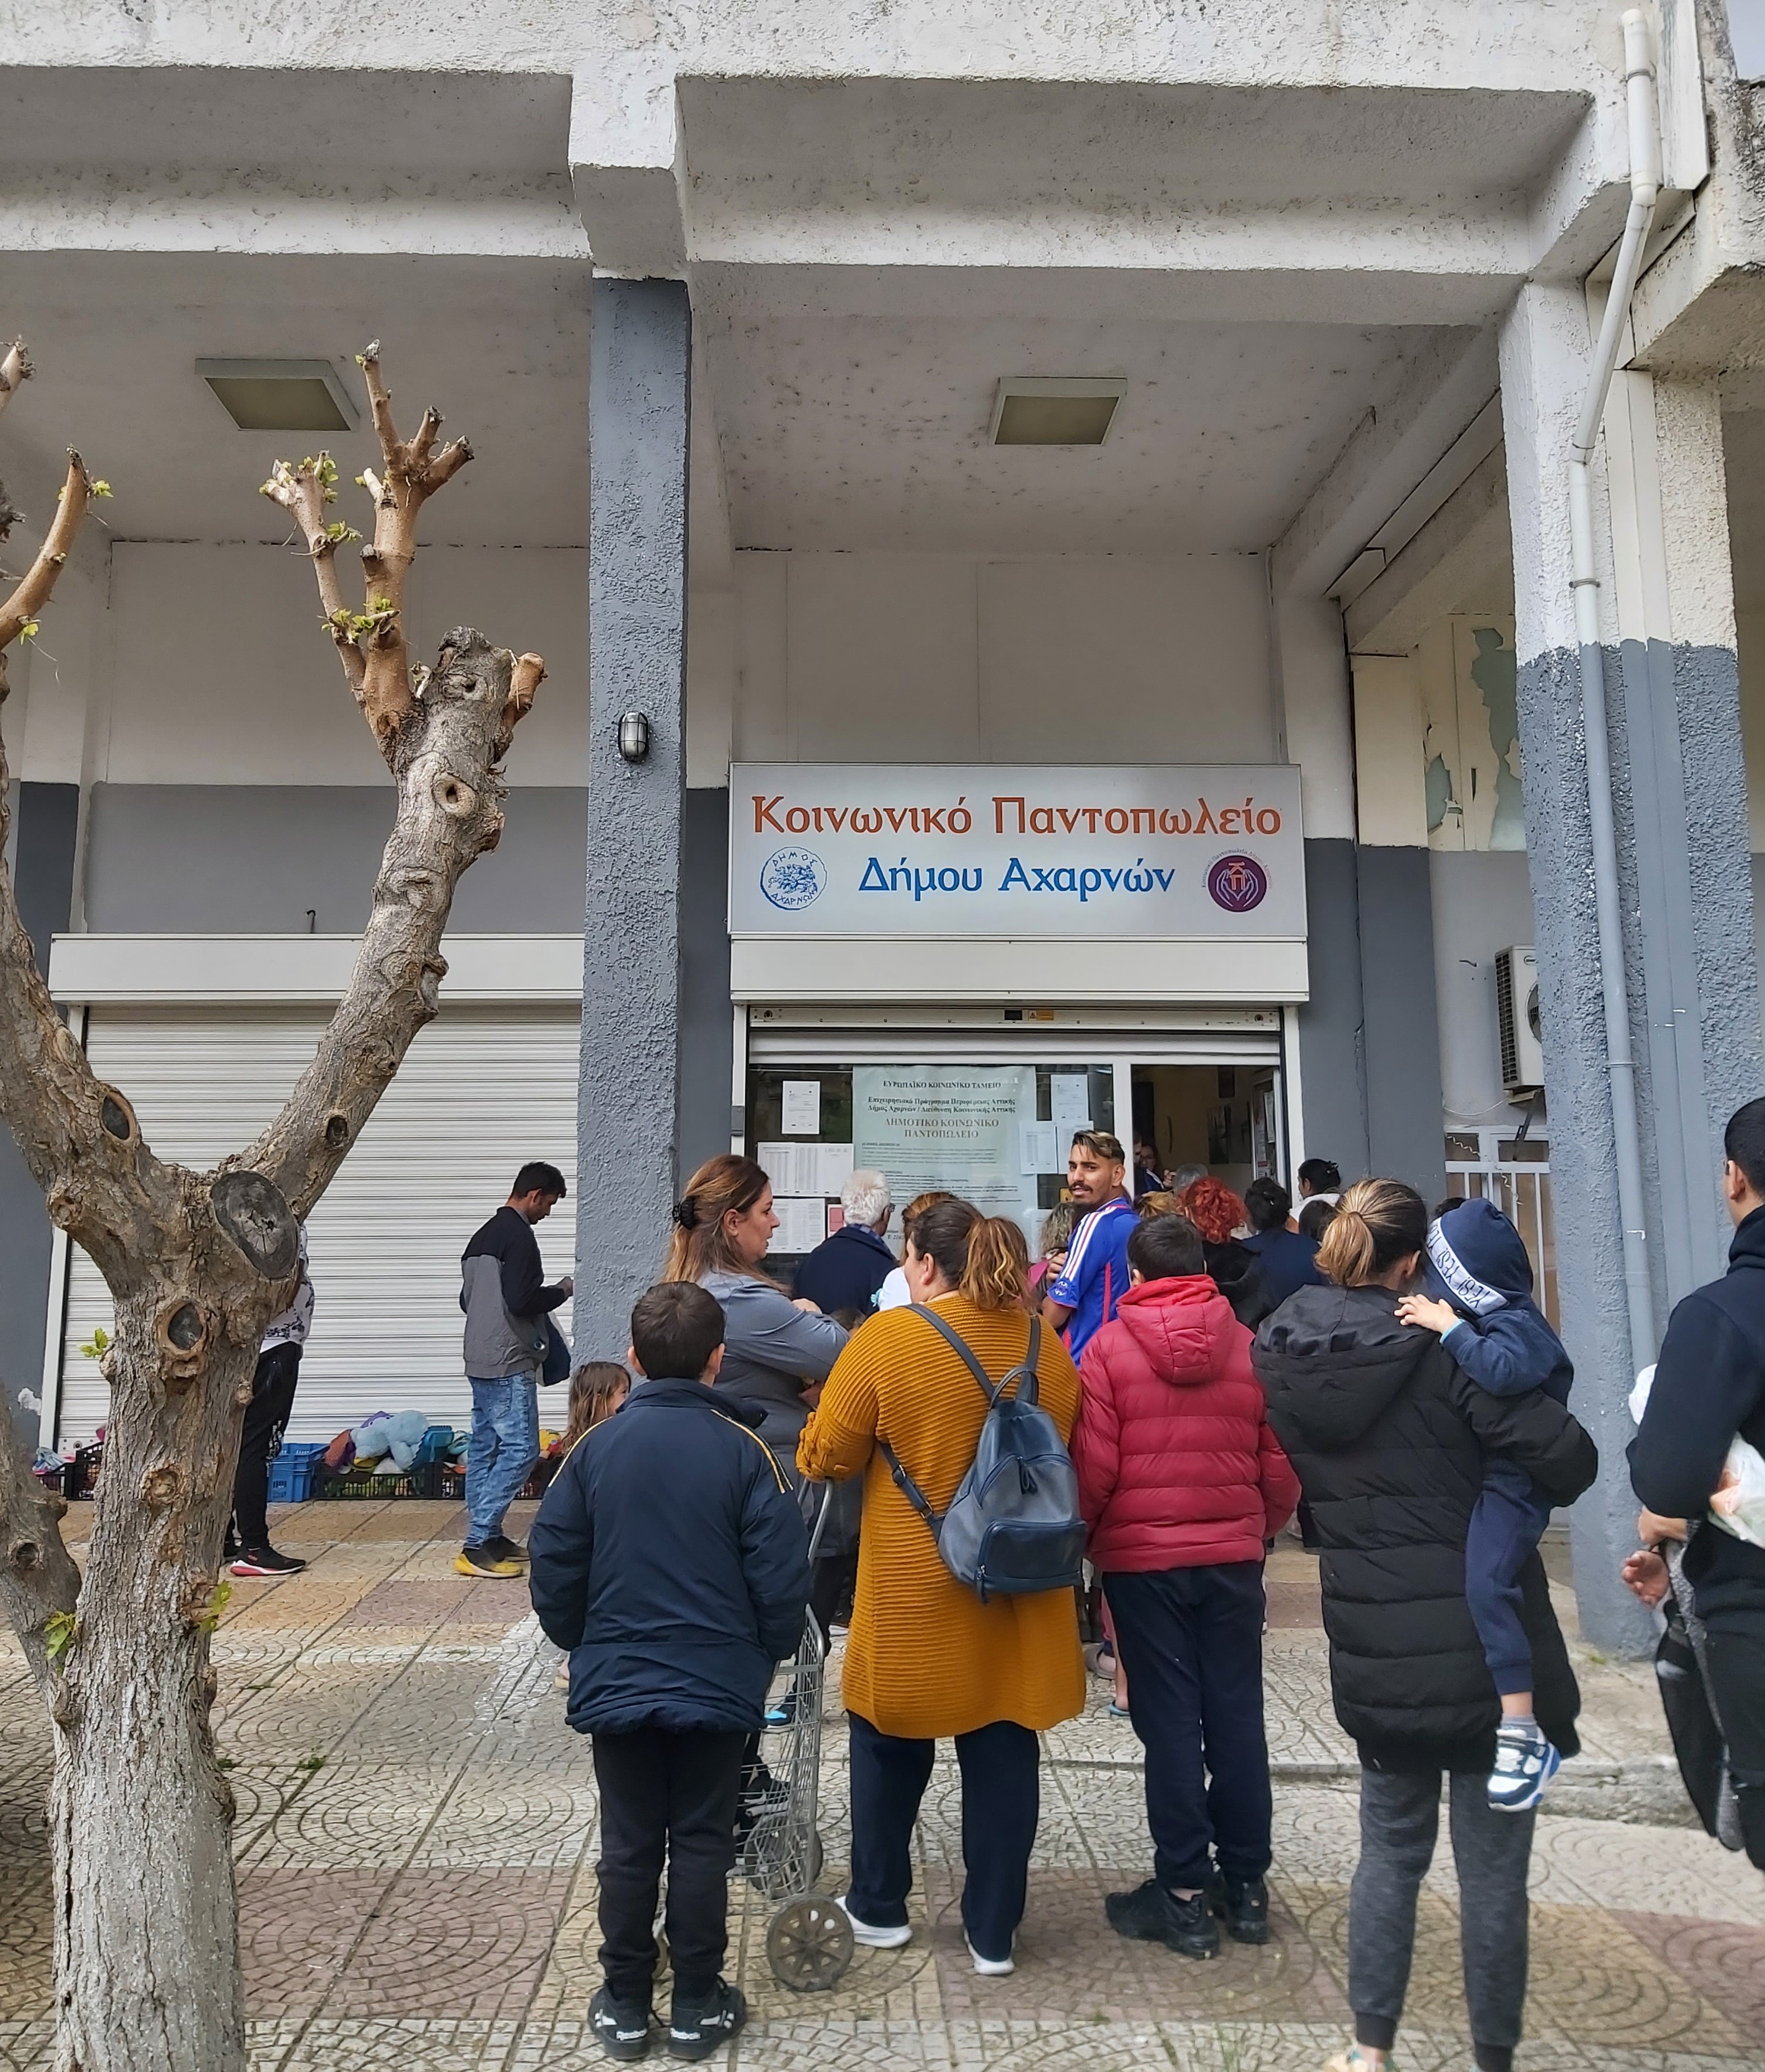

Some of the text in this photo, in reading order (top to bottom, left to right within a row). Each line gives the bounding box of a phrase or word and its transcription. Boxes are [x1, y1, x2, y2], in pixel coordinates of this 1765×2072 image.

[753, 797, 1280, 834] Κοινωνικό Παντοπωλείο
[773, 851, 818, 867] ΔΗΜΟΣ
[859, 858, 1174, 902] Δήμου Αχαρνών
[771, 890, 815, 905] ΑΧΑΡΝΩΝ
[883, 1080, 927, 1089] ΕΥΡΩΠΑΪΚΟ
[885, 1118, 999, 1127] ΔΗΜΟΤΙΚΟ ΚΟΙΝΩΝΙΚΟ
[904, 1129, 978, 1138] ΠΑΝΤΟΠΩΛΕΙΟ
[1436, 1247, 1460, 1284] YES!
[1456, 1276, 1490, 1309] YES!
